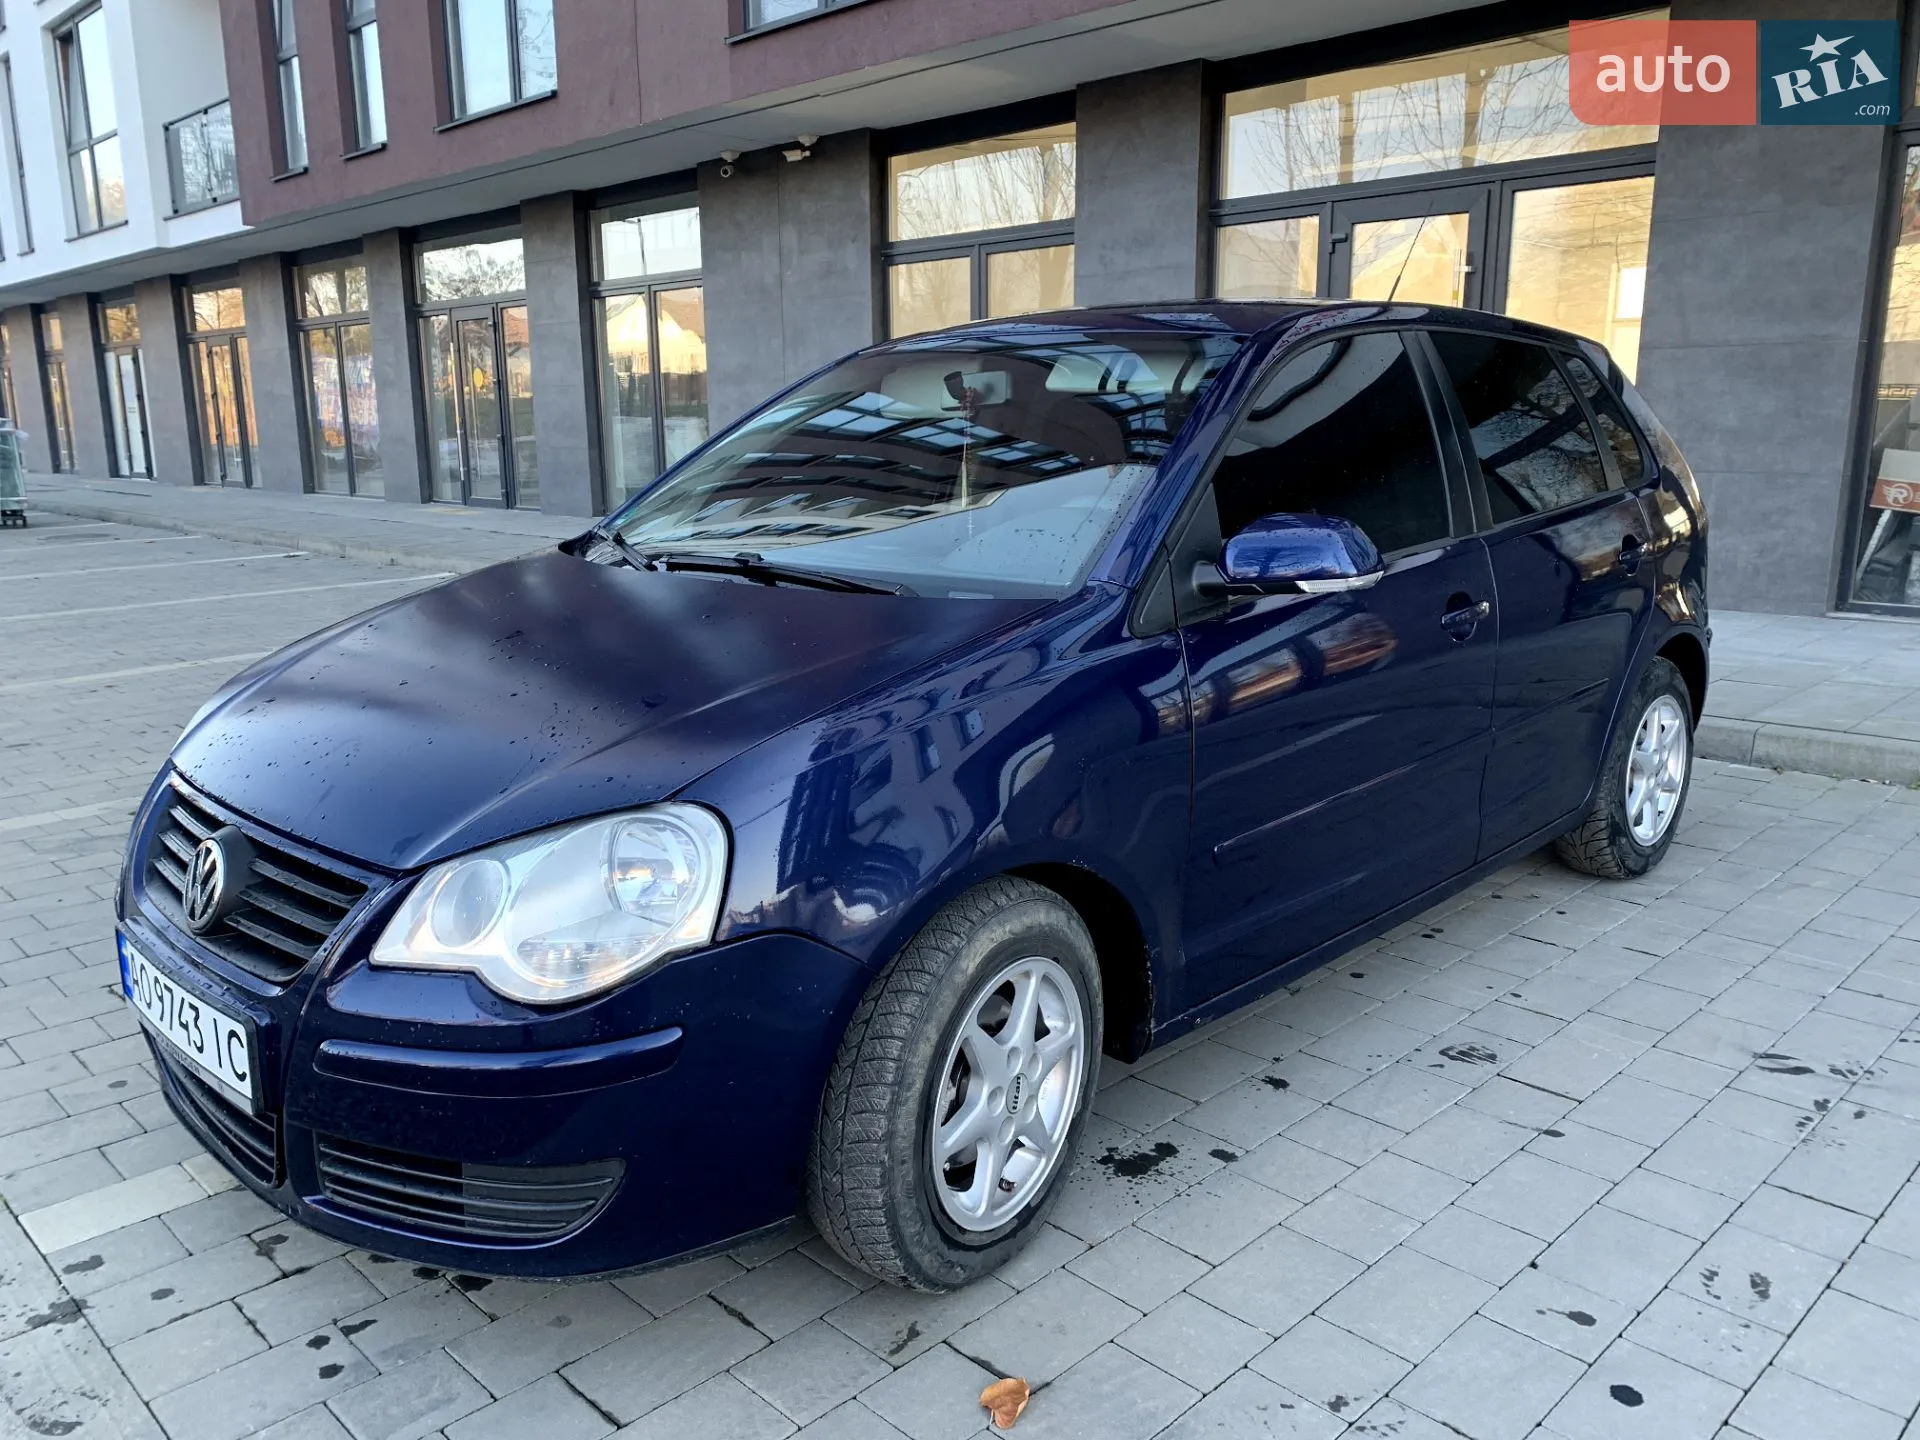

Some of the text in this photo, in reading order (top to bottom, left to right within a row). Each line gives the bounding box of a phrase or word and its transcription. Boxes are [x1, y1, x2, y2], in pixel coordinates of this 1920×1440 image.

[154, 976, 204, 1054] 9743
[213, 1017, 248, 1083] IC
[1011, 1076, 1021, 1110] titan
